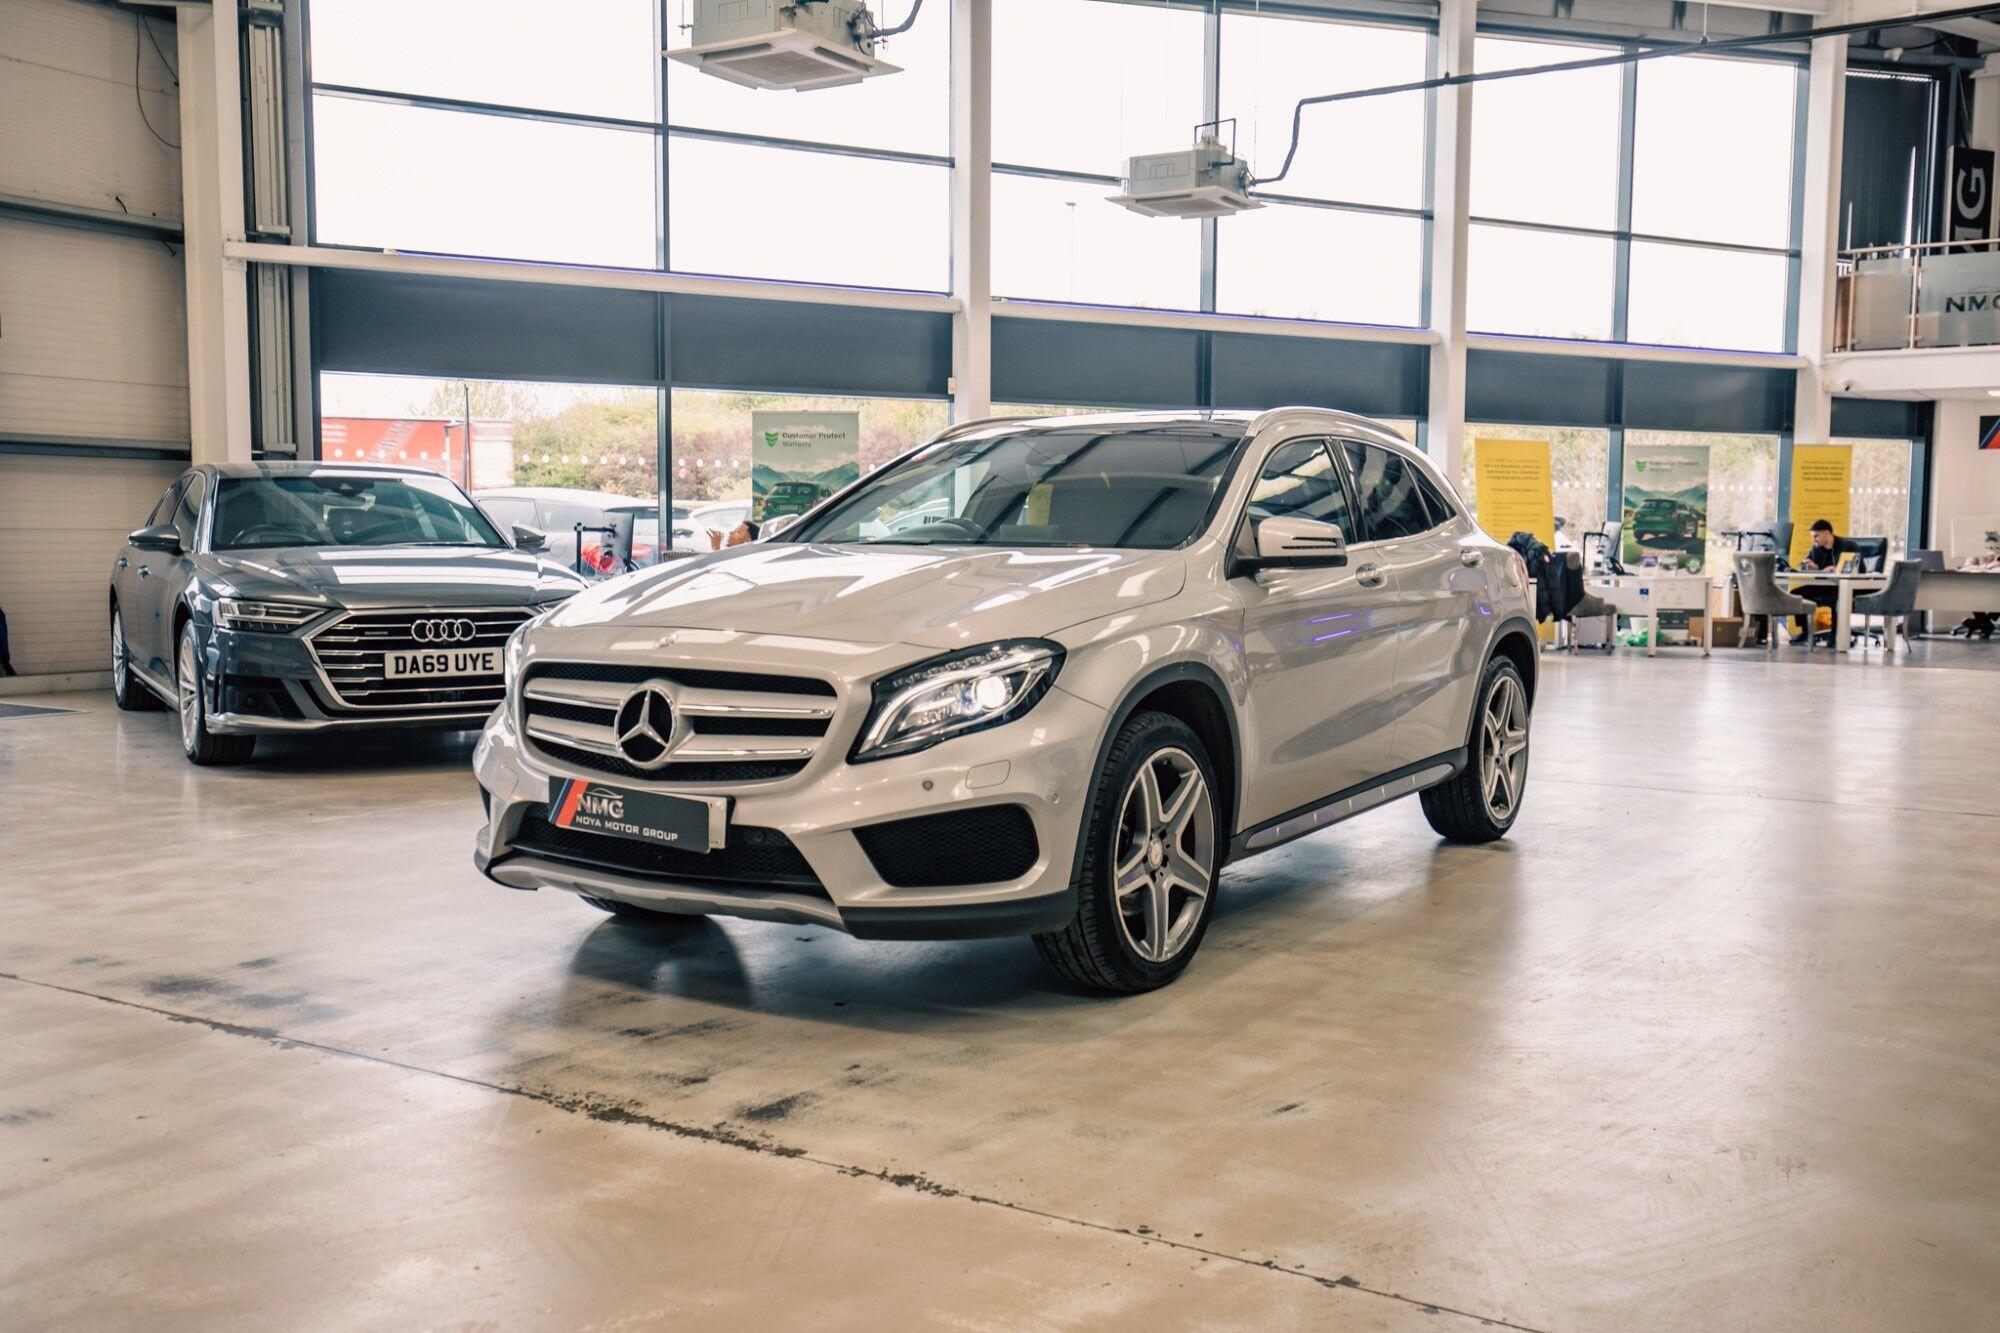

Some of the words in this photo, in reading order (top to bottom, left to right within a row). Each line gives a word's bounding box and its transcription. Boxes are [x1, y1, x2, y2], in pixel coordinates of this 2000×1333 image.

[818, 432, 846, 440] Protect
[394, 654, 449, 675] DA69
[455, 652, 494, 672] UYE
[577, 793, 624, 818] NMG
[575, 816, 602, 827] NOVA
[605, 821, 640, 835] MOTOR
[643, 827, 679, 842] GROUP
